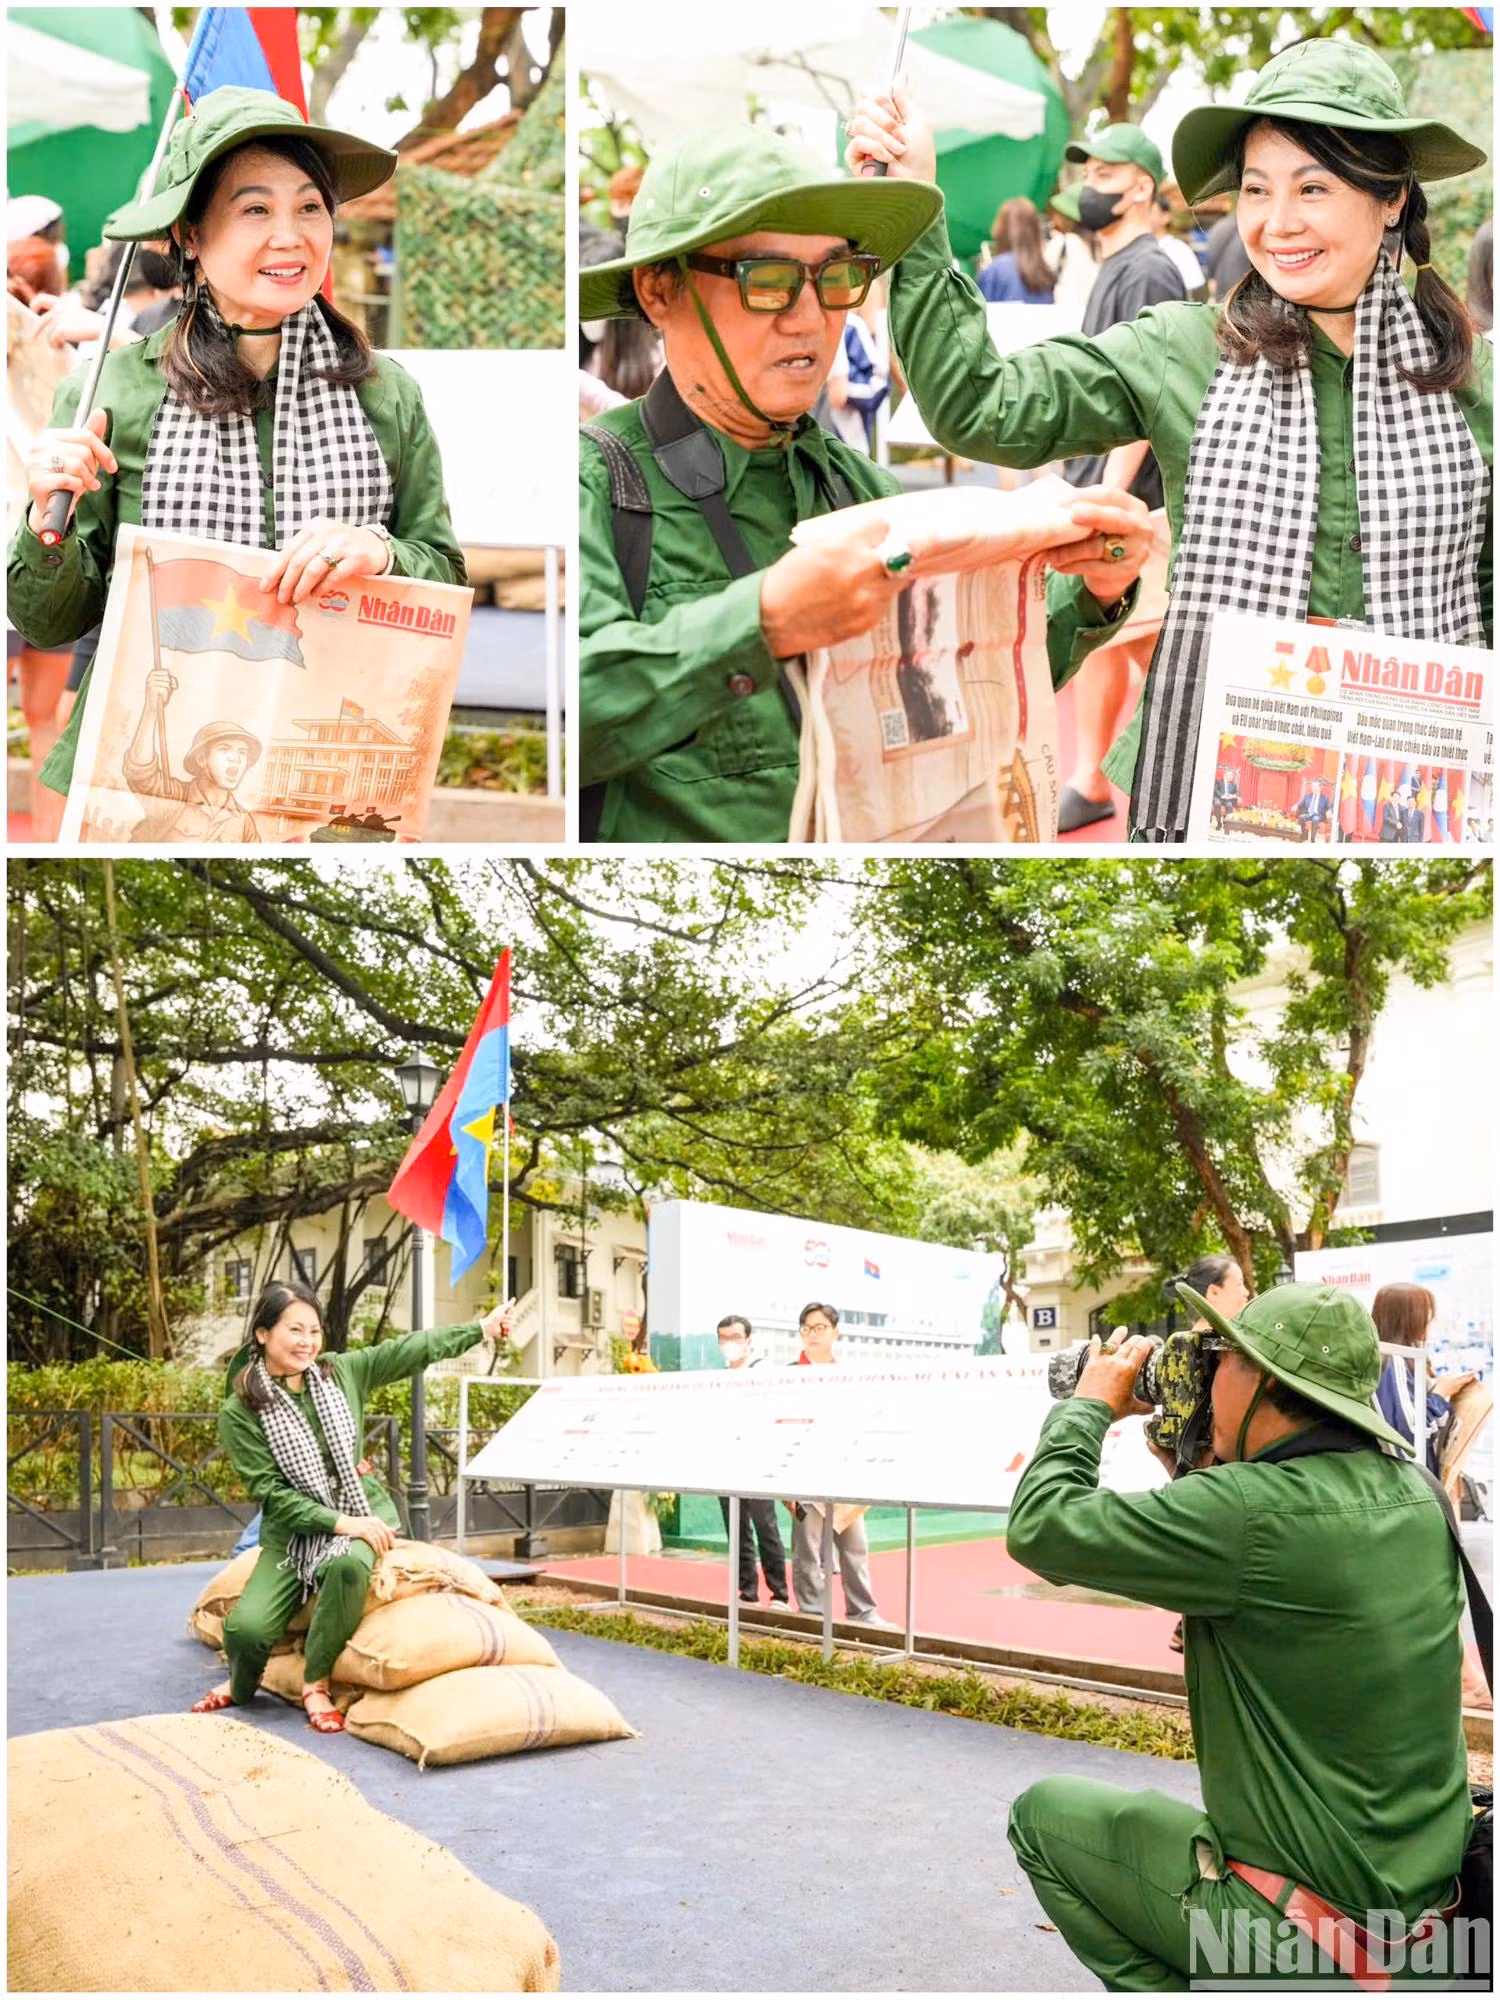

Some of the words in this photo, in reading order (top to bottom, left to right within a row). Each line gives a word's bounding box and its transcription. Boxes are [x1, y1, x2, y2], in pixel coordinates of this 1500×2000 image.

[358, 595, 414, 626] Nhân
[415, 605, 457, 634] Dân
[1341, 649, 1419, 691] Nhân
[1424, 662, 1484, 700] Dân
[1310, 706, 1343, 722] Philippines
[1036, 1309, 1053, 1326] B
